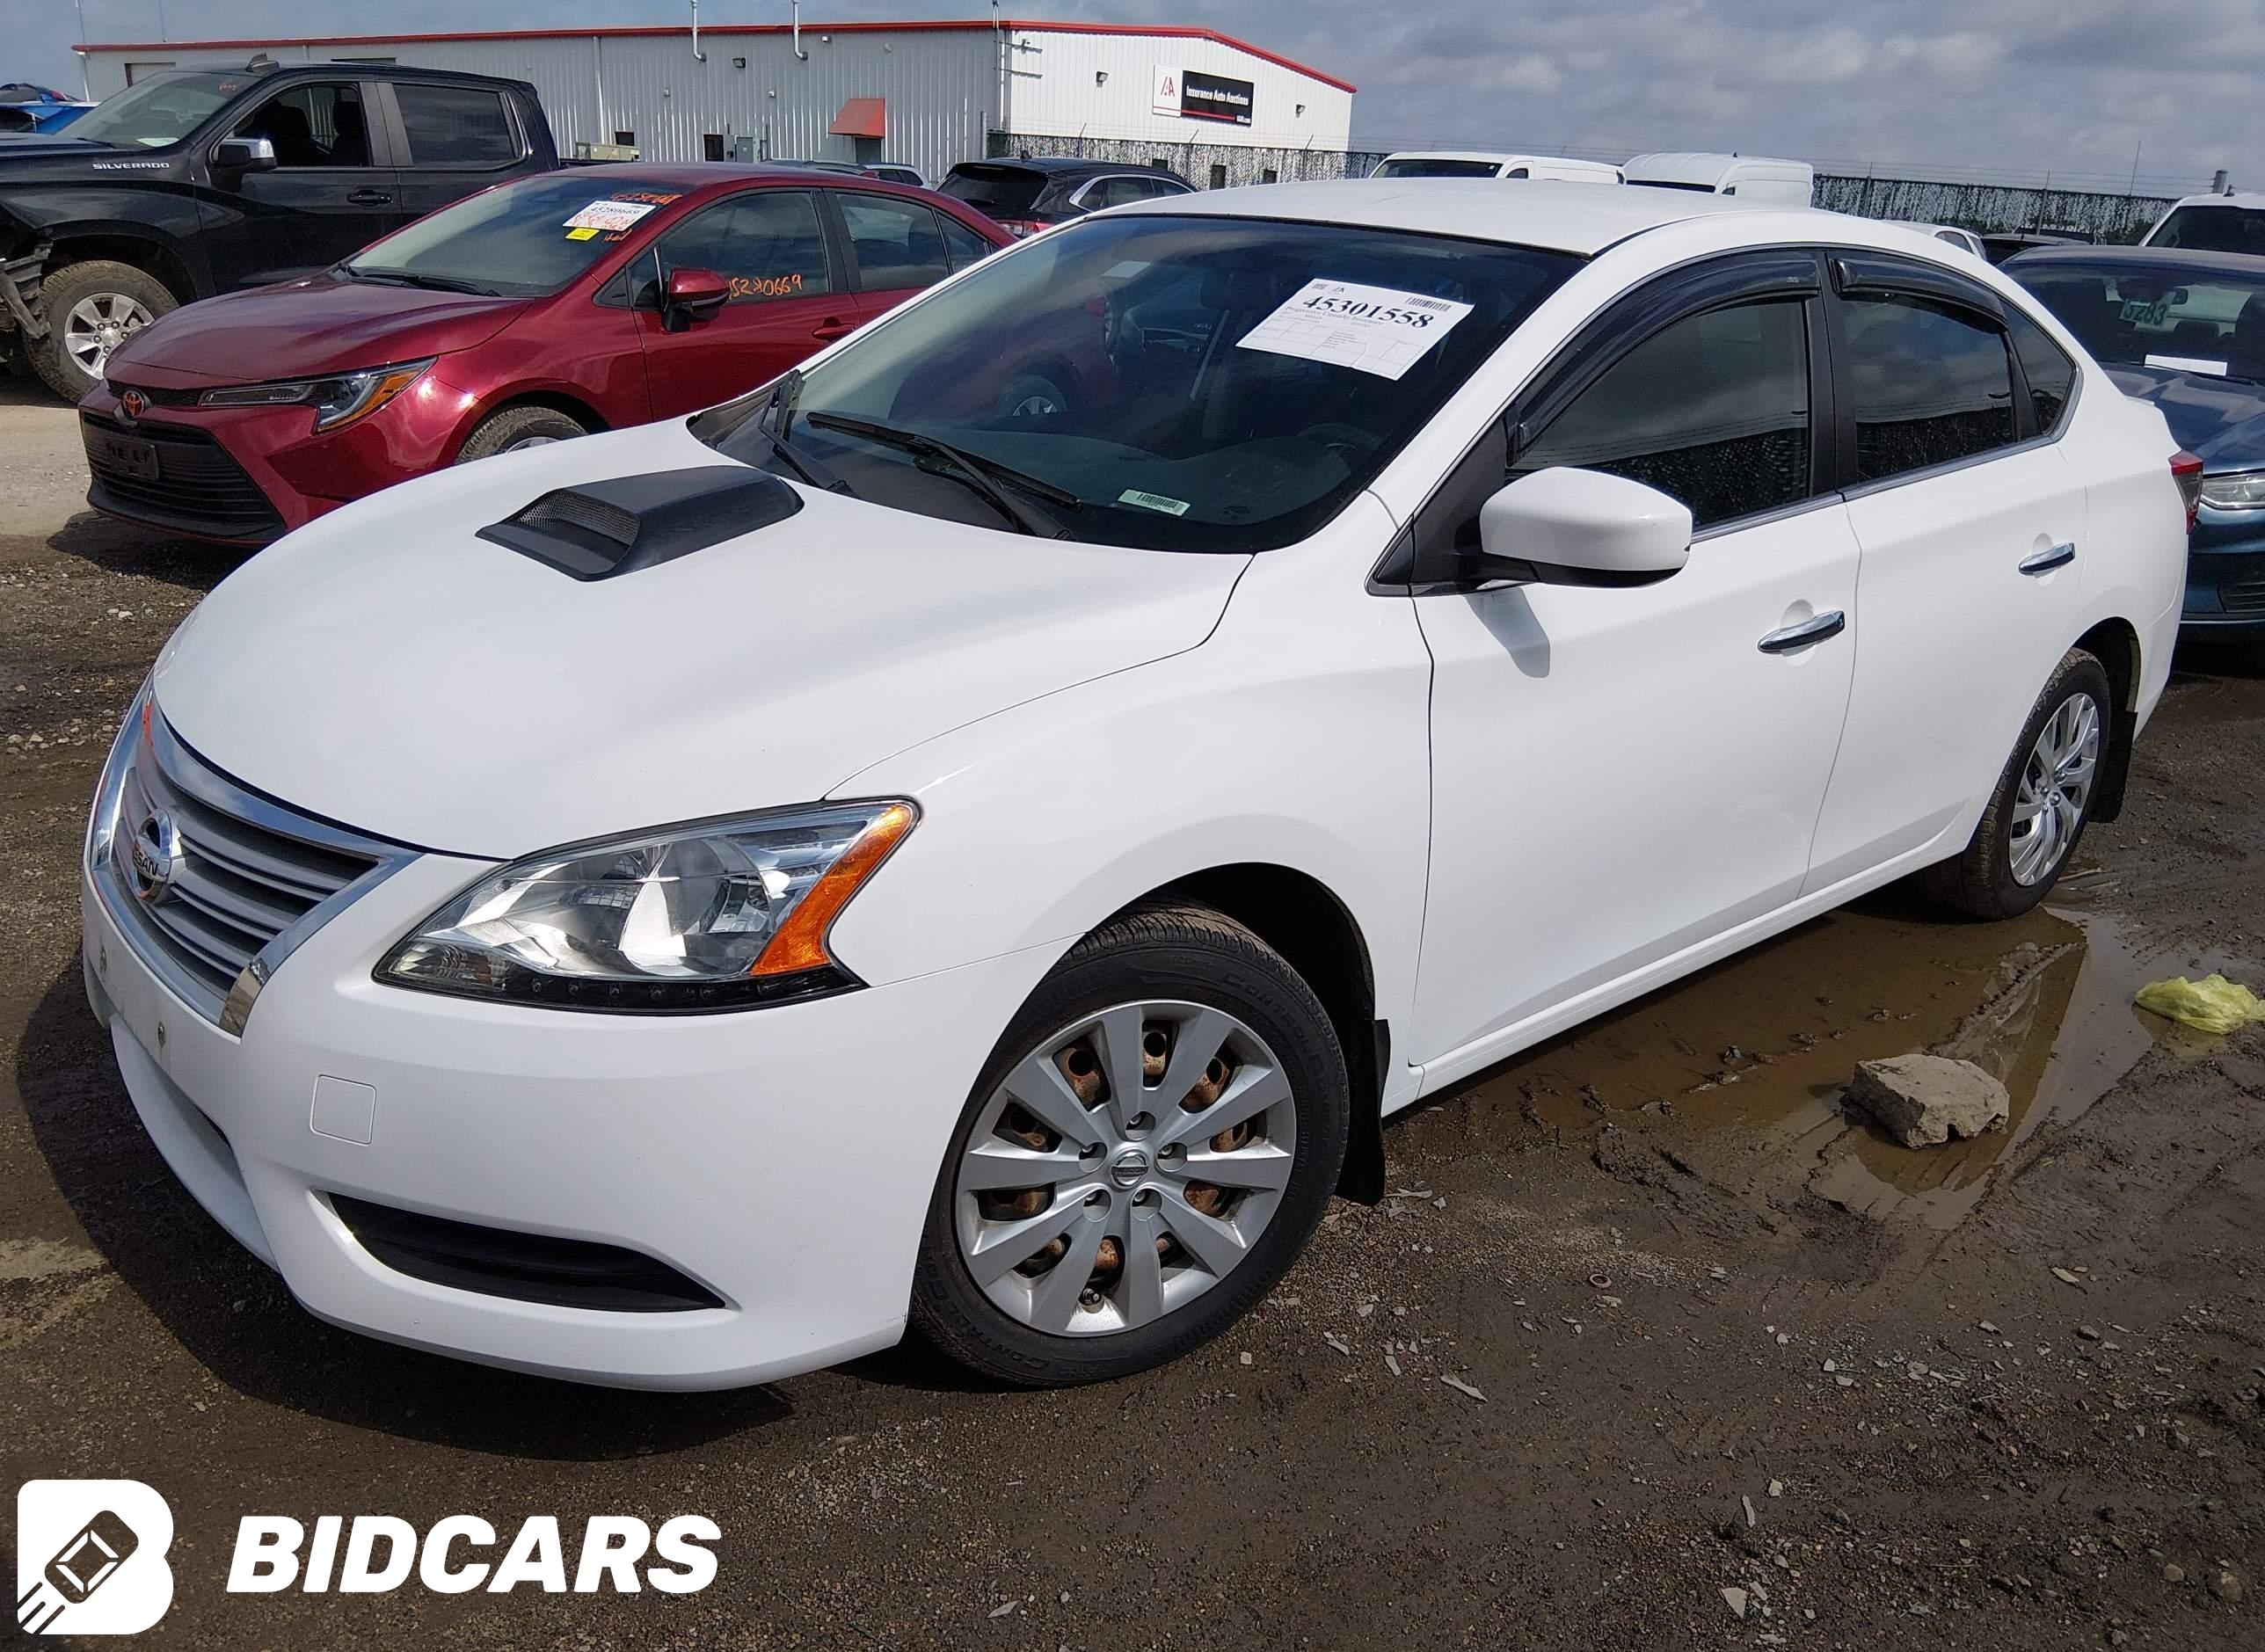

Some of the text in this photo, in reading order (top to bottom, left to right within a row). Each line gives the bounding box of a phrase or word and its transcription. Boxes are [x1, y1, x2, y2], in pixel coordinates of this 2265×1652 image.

[1186, 84, 1249, 106] Insurance Auto Auctions
[1303, 295, 1435, 329] 45301558
[133, 848, 159, 877] SSAN
